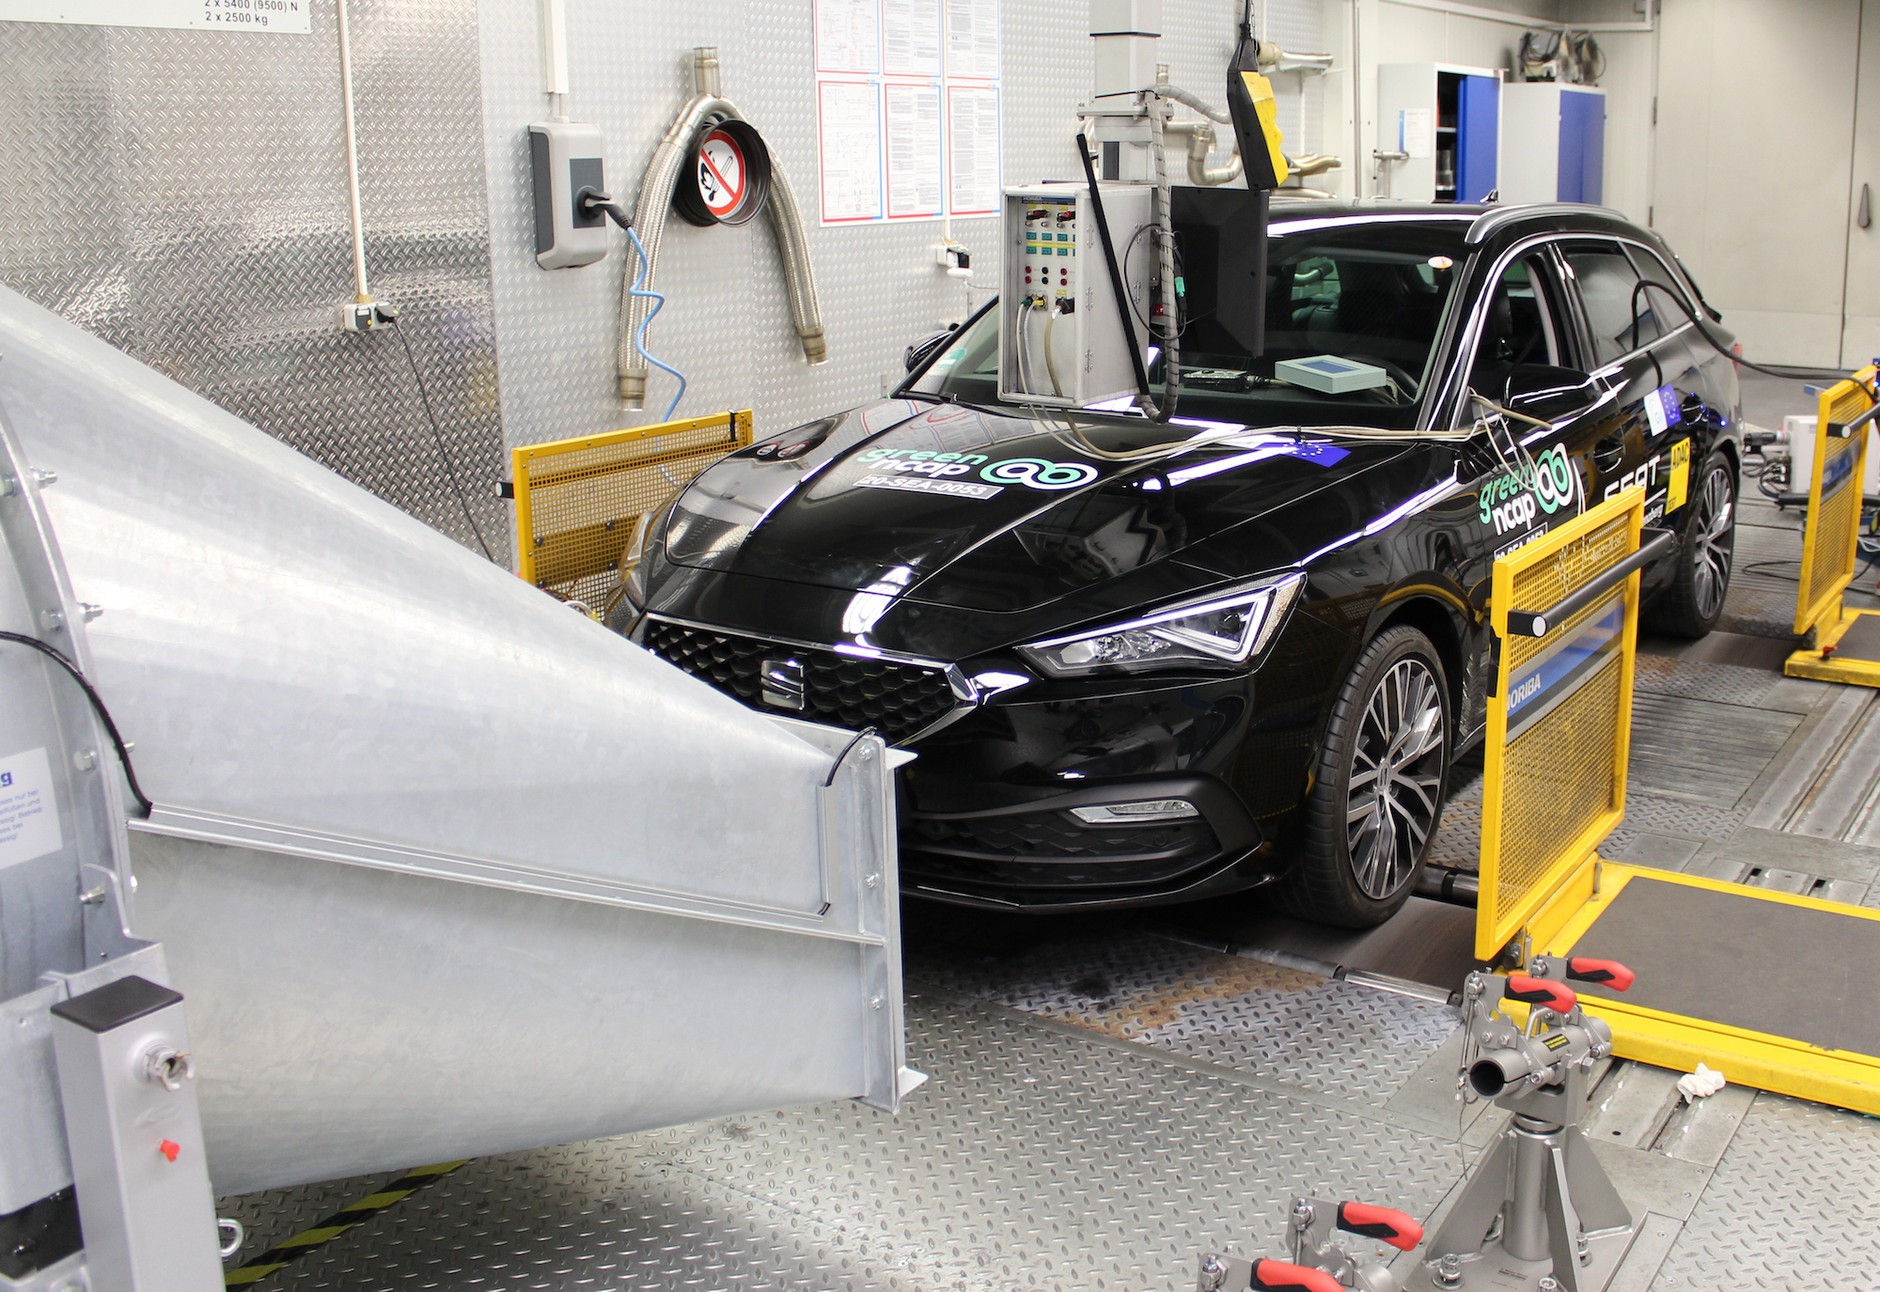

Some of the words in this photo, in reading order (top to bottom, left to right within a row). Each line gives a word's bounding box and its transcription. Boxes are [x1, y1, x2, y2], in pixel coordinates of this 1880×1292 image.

[224, 0, 250, 9] 5400
[254, 0, 287, 13] (9500)
[291, 2, 298, 11] N
[205, 11, 212, 21] 2
[225, 12, 251, 23] 2500
[255, 14, 268, 26] kg
[857, 448, 989, 466] green
[868, 459, 970, 478] ncap
[861, 475, 988, 496] 20-SEA-0053
[1480, 464, 1532, 525] green
[1492, 492, 1536, 536] ncap
